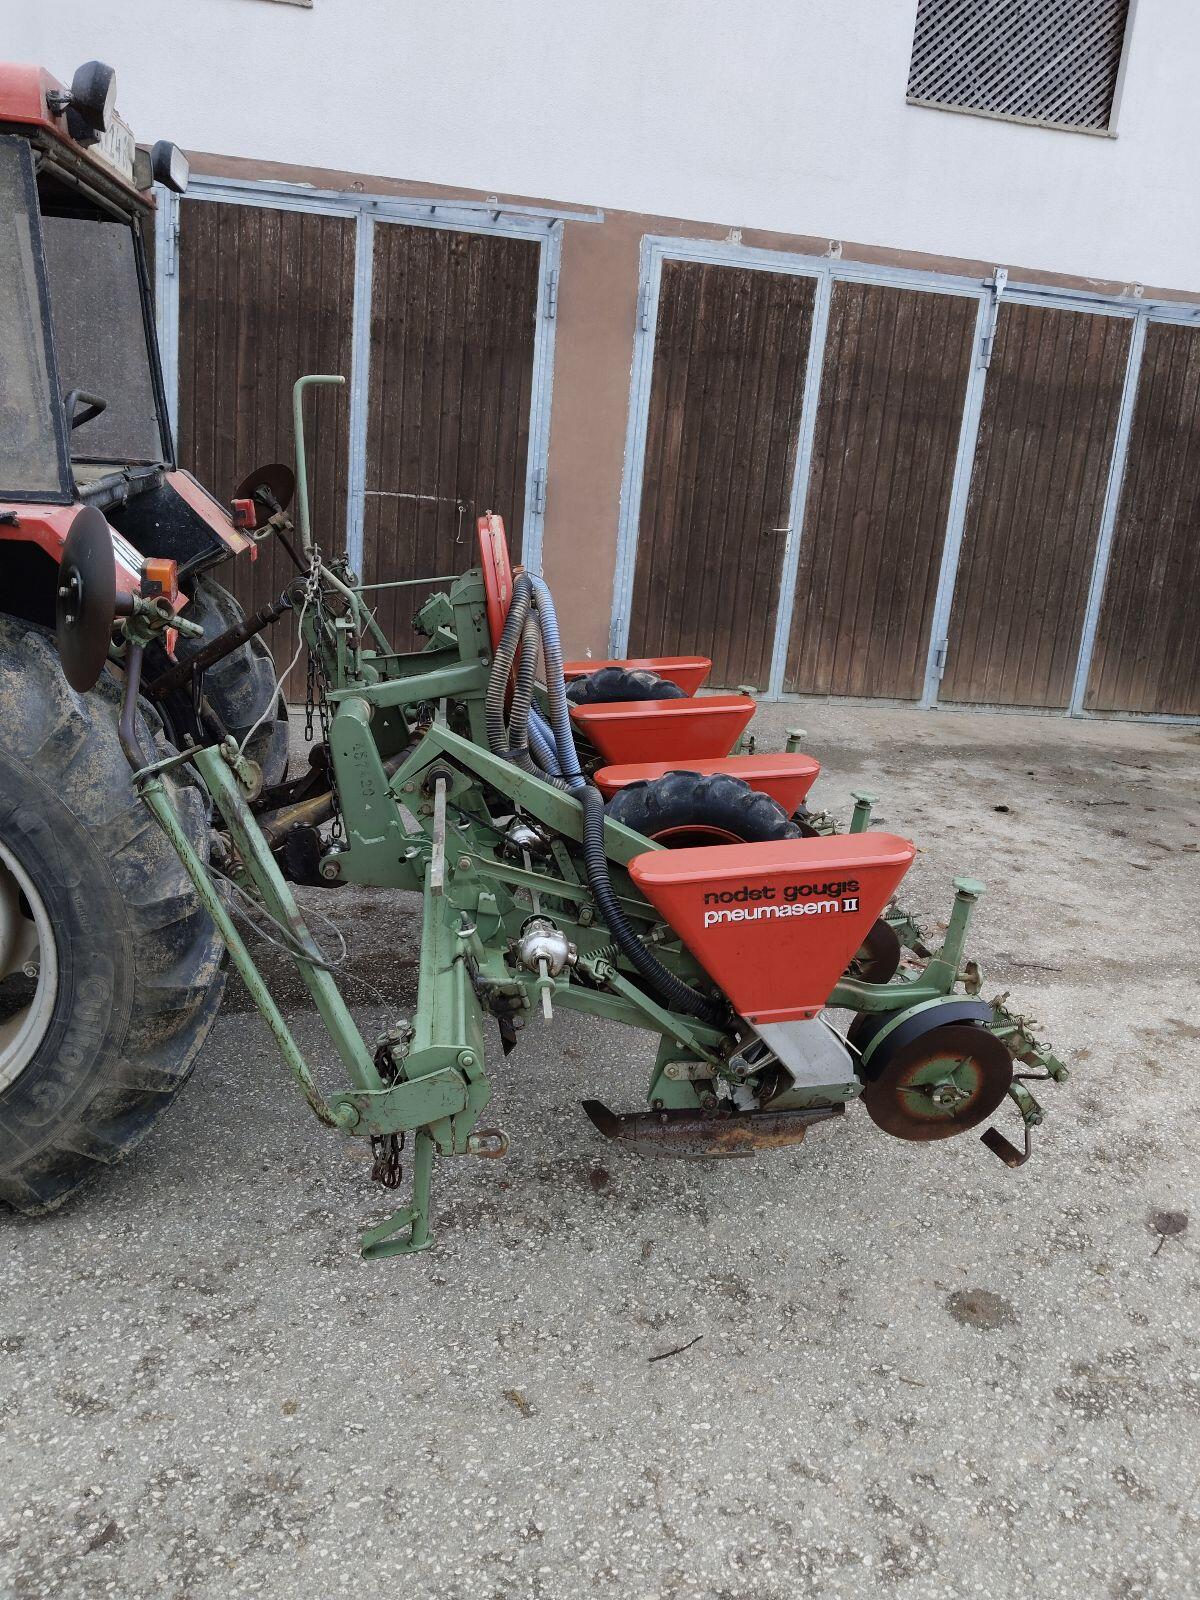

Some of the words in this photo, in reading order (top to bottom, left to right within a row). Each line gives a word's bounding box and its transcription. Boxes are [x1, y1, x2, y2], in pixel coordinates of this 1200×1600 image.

[783, 880, 860, 900] gougis
[704, 900, 838, 928] pneumasem
[843, 898, 858, 912] II
